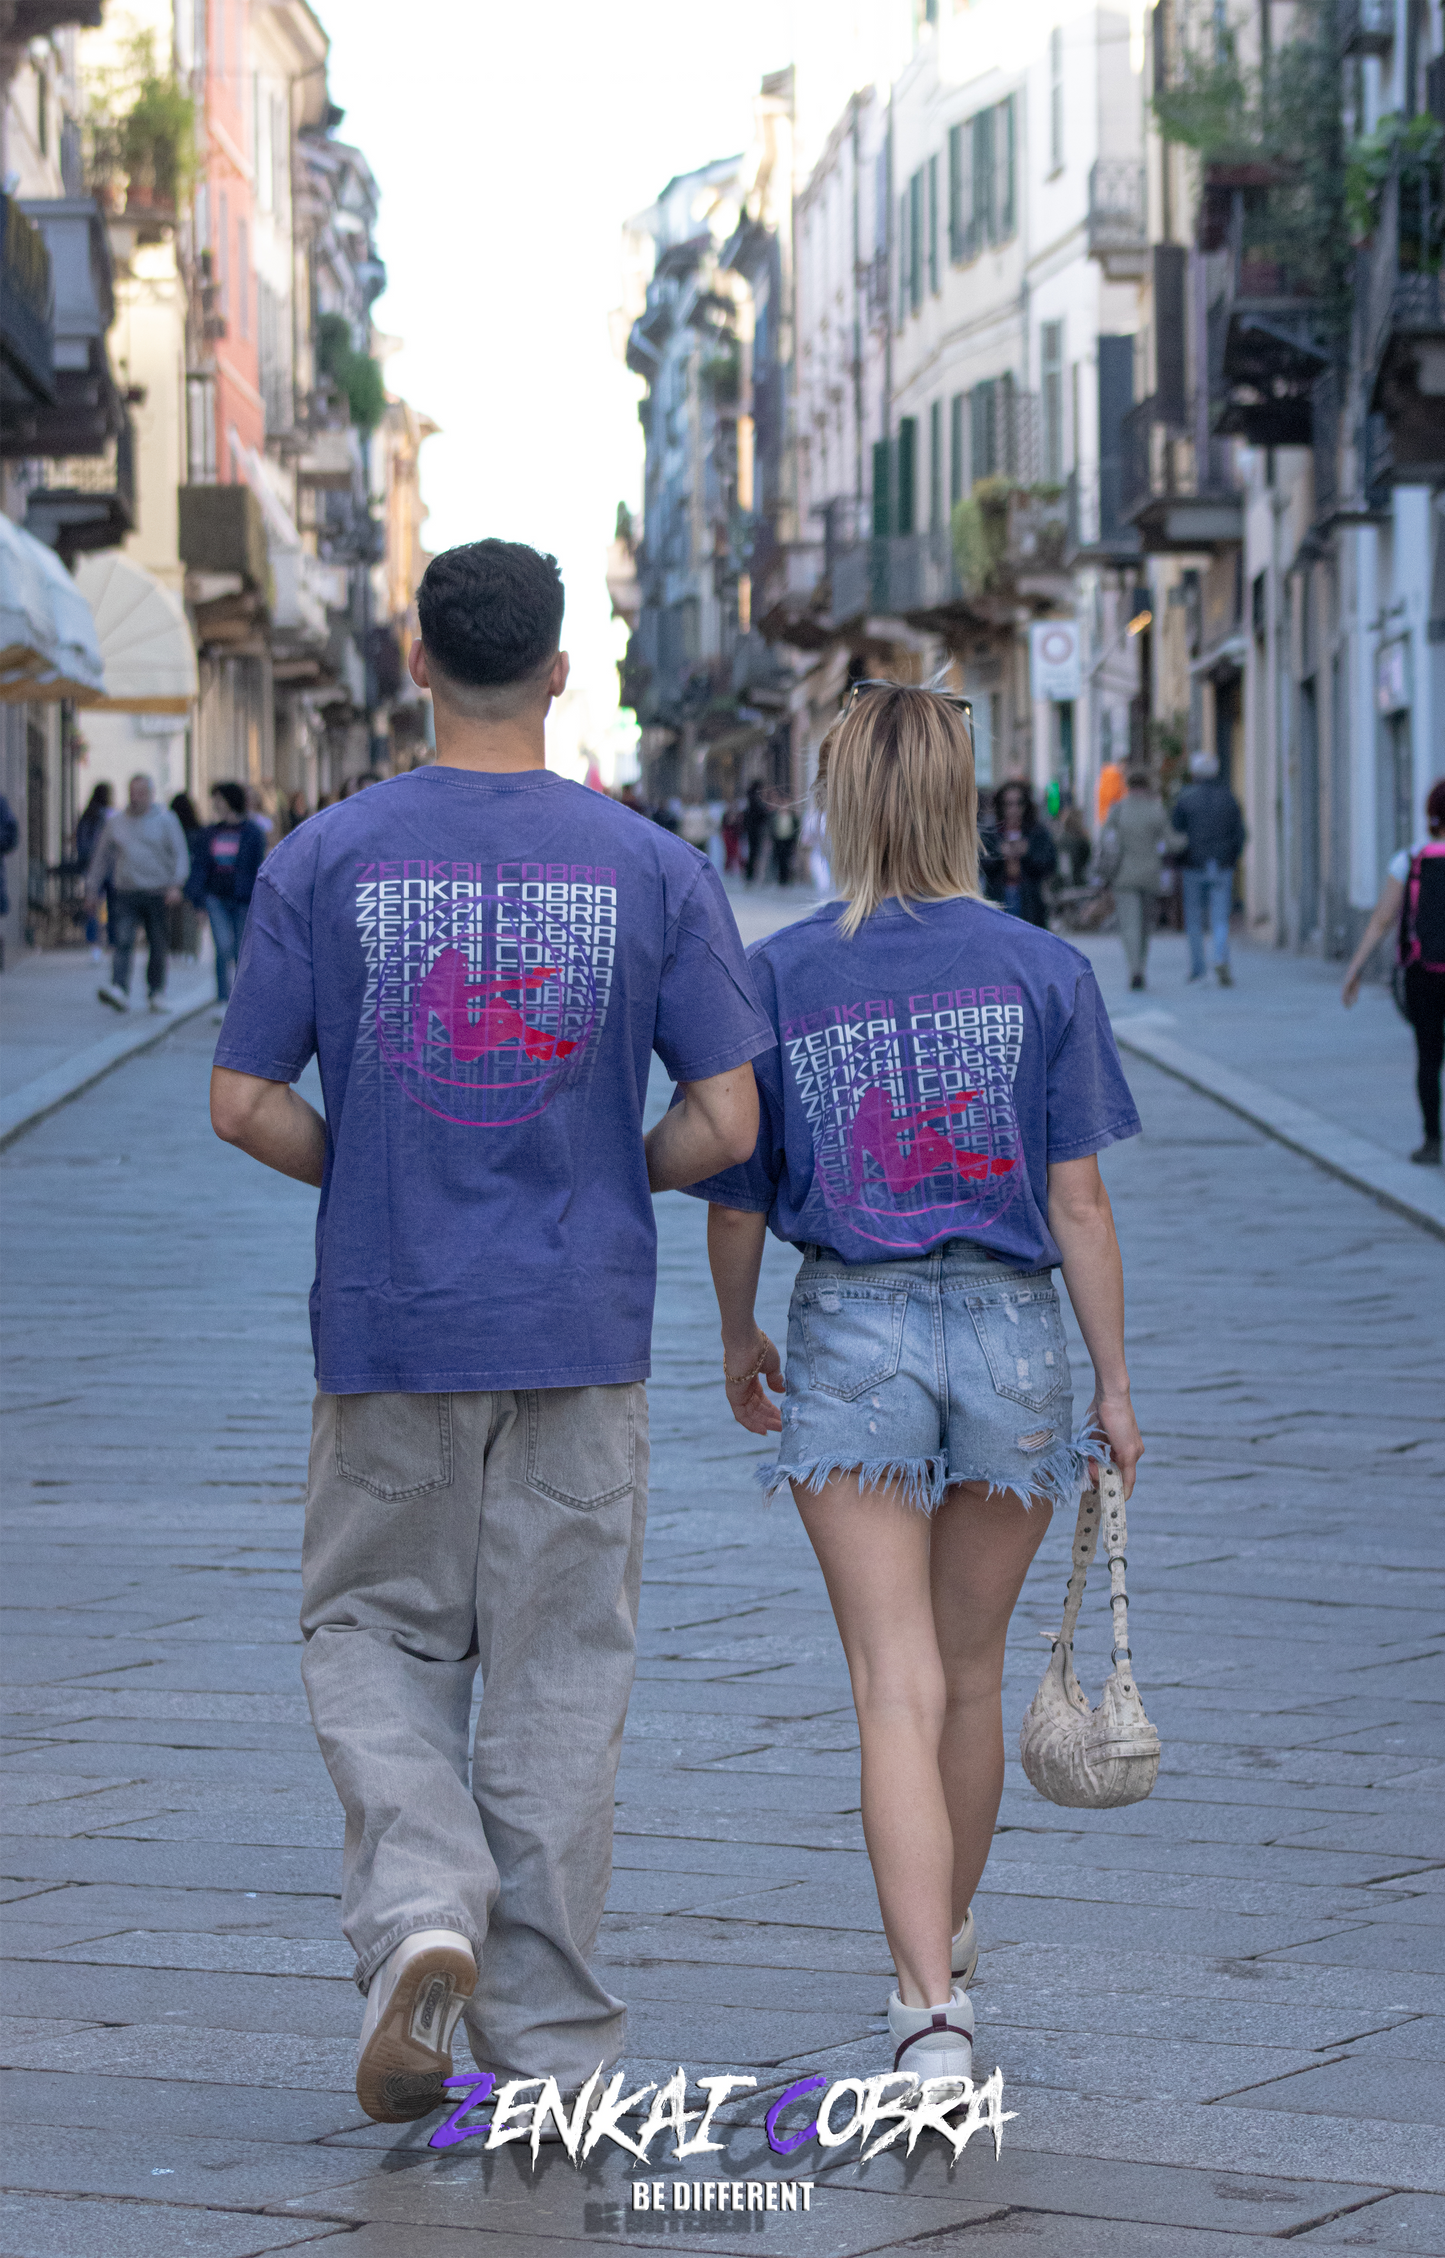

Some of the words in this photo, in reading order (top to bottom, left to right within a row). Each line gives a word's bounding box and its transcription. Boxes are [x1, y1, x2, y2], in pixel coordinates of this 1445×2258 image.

[355, 860, 482, 883] ZENKAI
[496, 863, 617, 887] COBRA
[355, 880, 482, 903] ZENKAI
[497, 882, 617, 906] COBRA
[355, 900, 483, 923] ZENKAI
[496, 902, 617, 926] COBRA
[356, 920, 483, 943] ZENKAI
[496, 922, 617, 947] COBRA
[496, 943, 615, 967] COBRA
[908, 985, 1022, 1015] COBRA
[785, 1017, 897, 1061] ZENKAI
[911, 1004, 1024, 1031] COBRA
[791, 1035, 900, 1080] ZENKAI
[914, 1024, 1024, 1054] COBRA
[796, 1057, 902, 1100] ZENKAI
[915, 1043, 1022, 1074] COBRA
